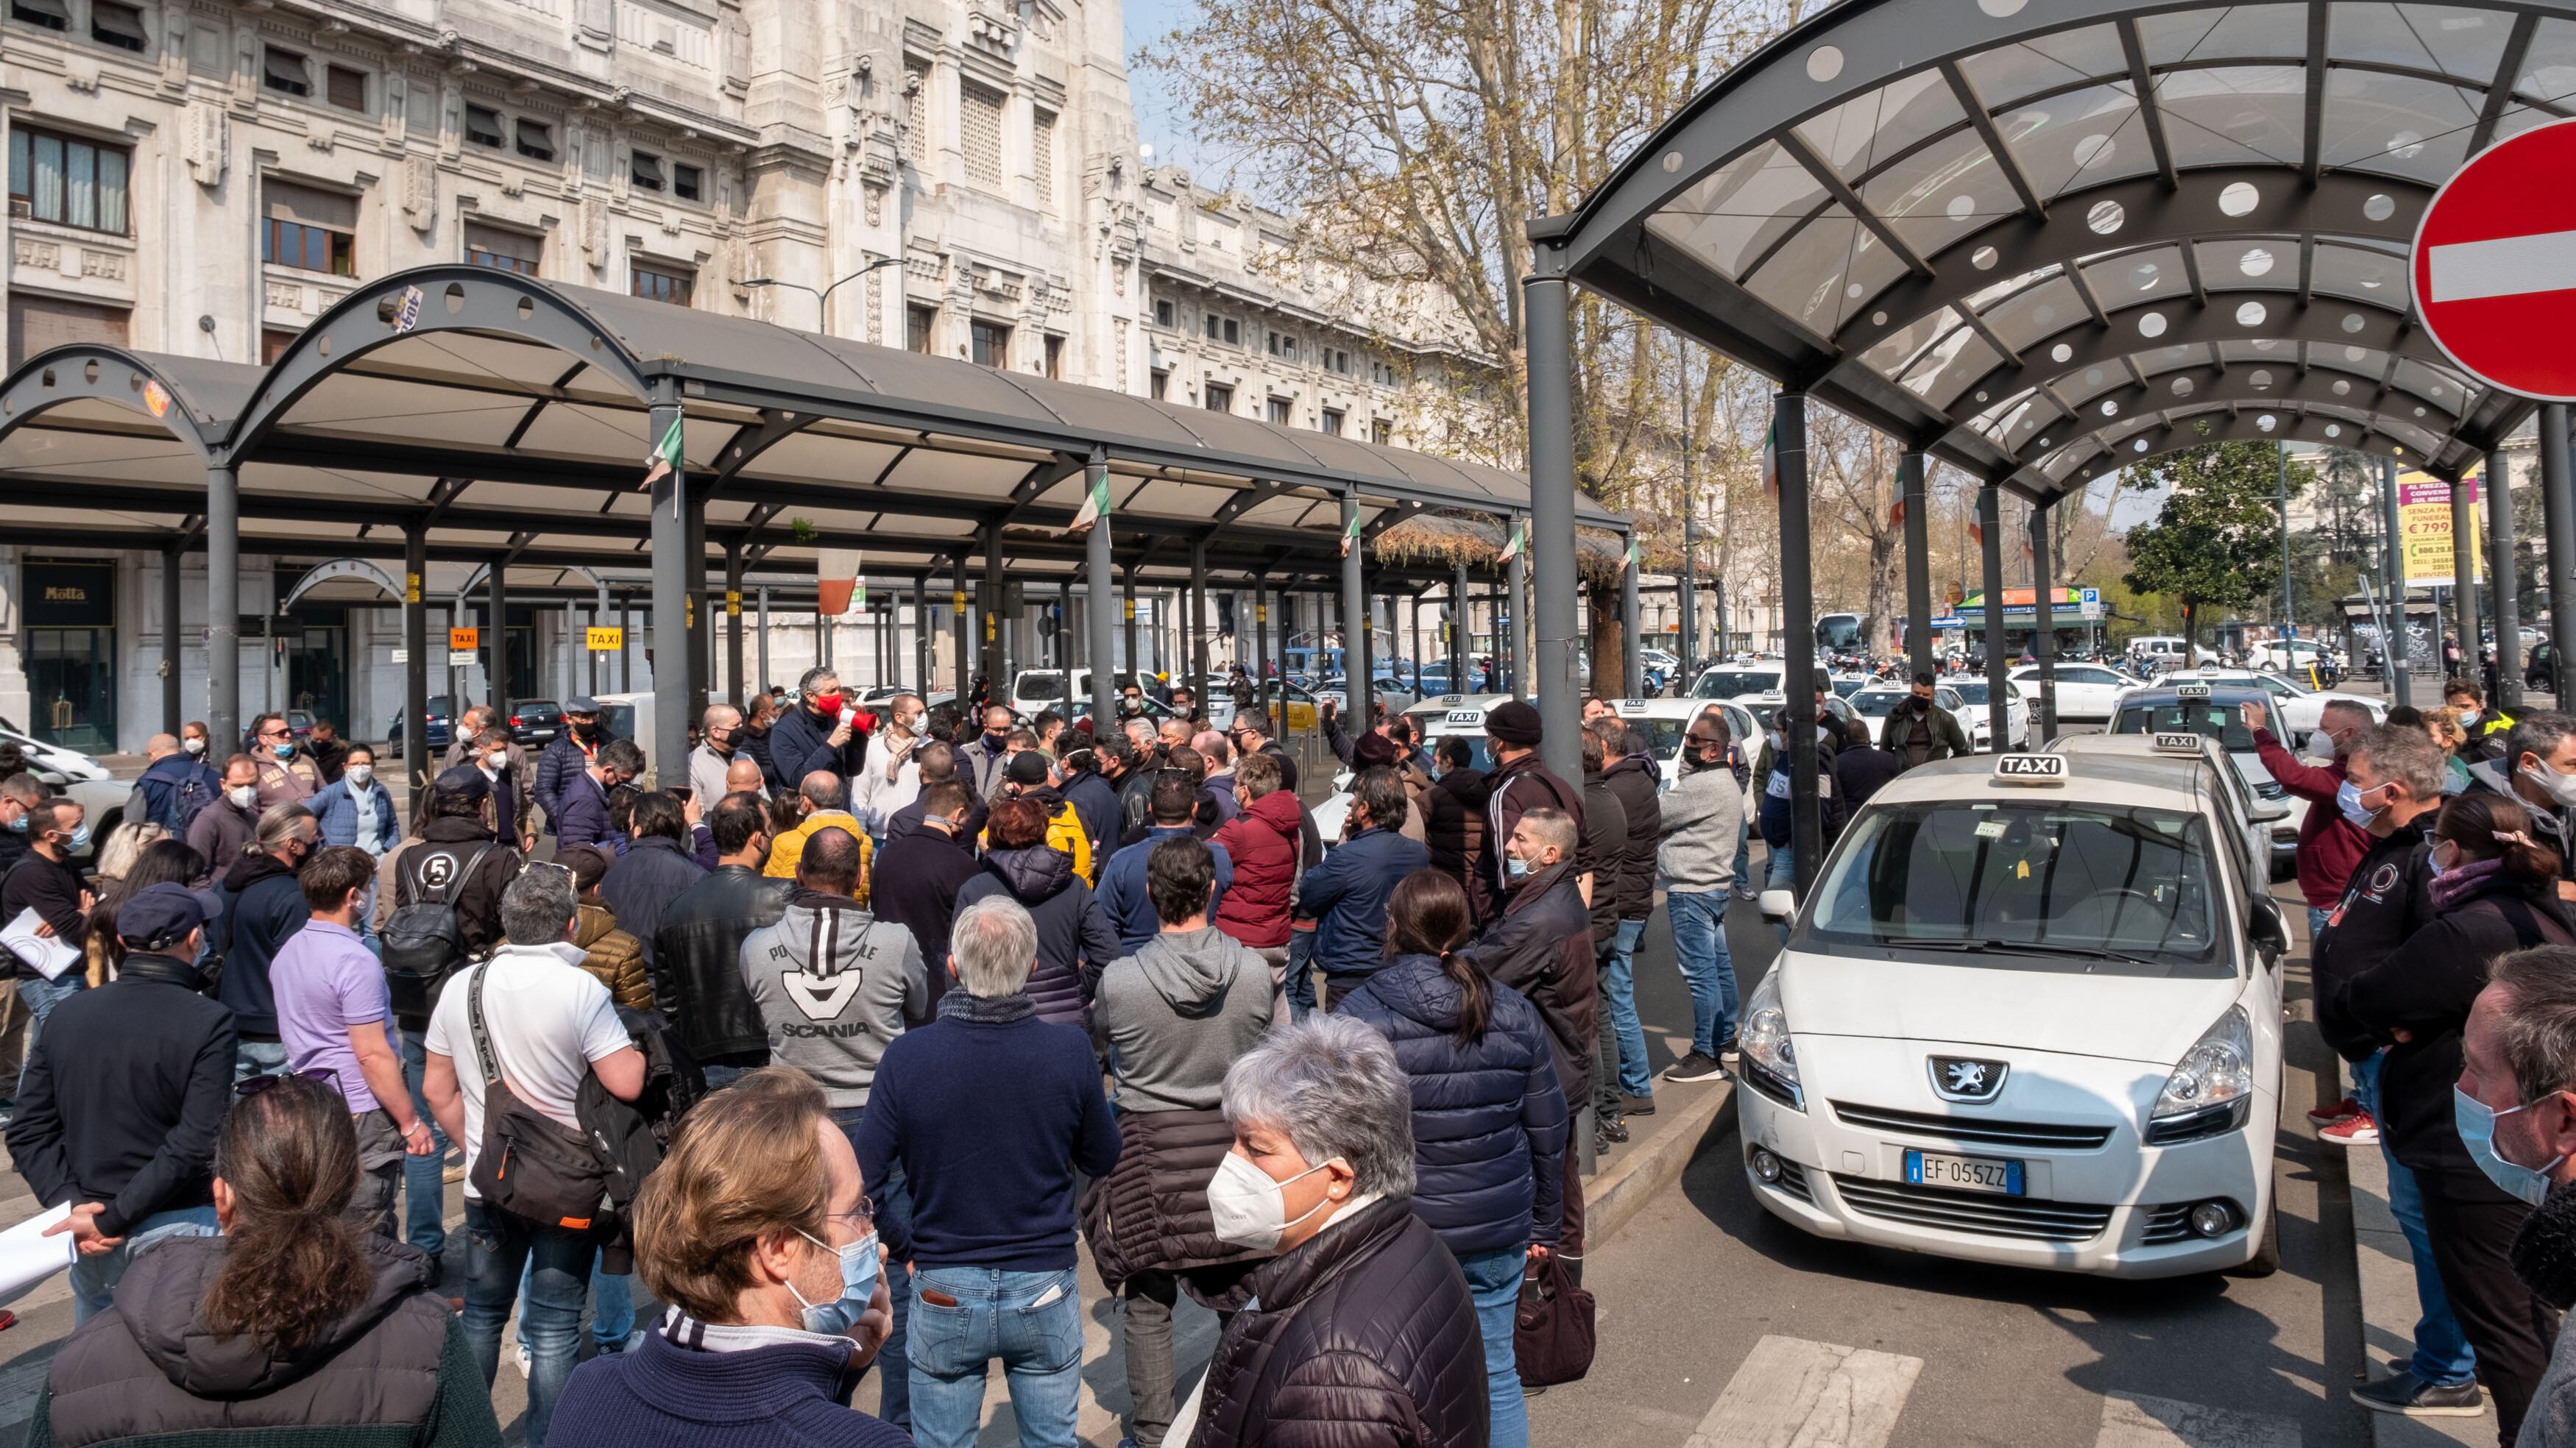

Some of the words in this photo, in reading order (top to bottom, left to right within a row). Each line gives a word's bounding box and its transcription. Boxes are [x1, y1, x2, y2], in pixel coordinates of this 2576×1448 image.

[2408, 524, 2418, 533] €
[45, 587, 85, 600] Motta
[2085, 591, 2094, 601] P
[455, 634, 474, 642] TAXI
[590, 634, 618, 644] TAXI
[1450, 713, 1477, 721] TAXI
[2159, 737, 2193, 746] TAXI
[2003, 759, 2058, 773] TAXI
[431, 859, 447, 881] 5
[782, 1021, 871, 1038] SCANIA
[1925, 1159, 1945, 1179] EF
[1951, 1162, 2006, 1187] 055ZZ
